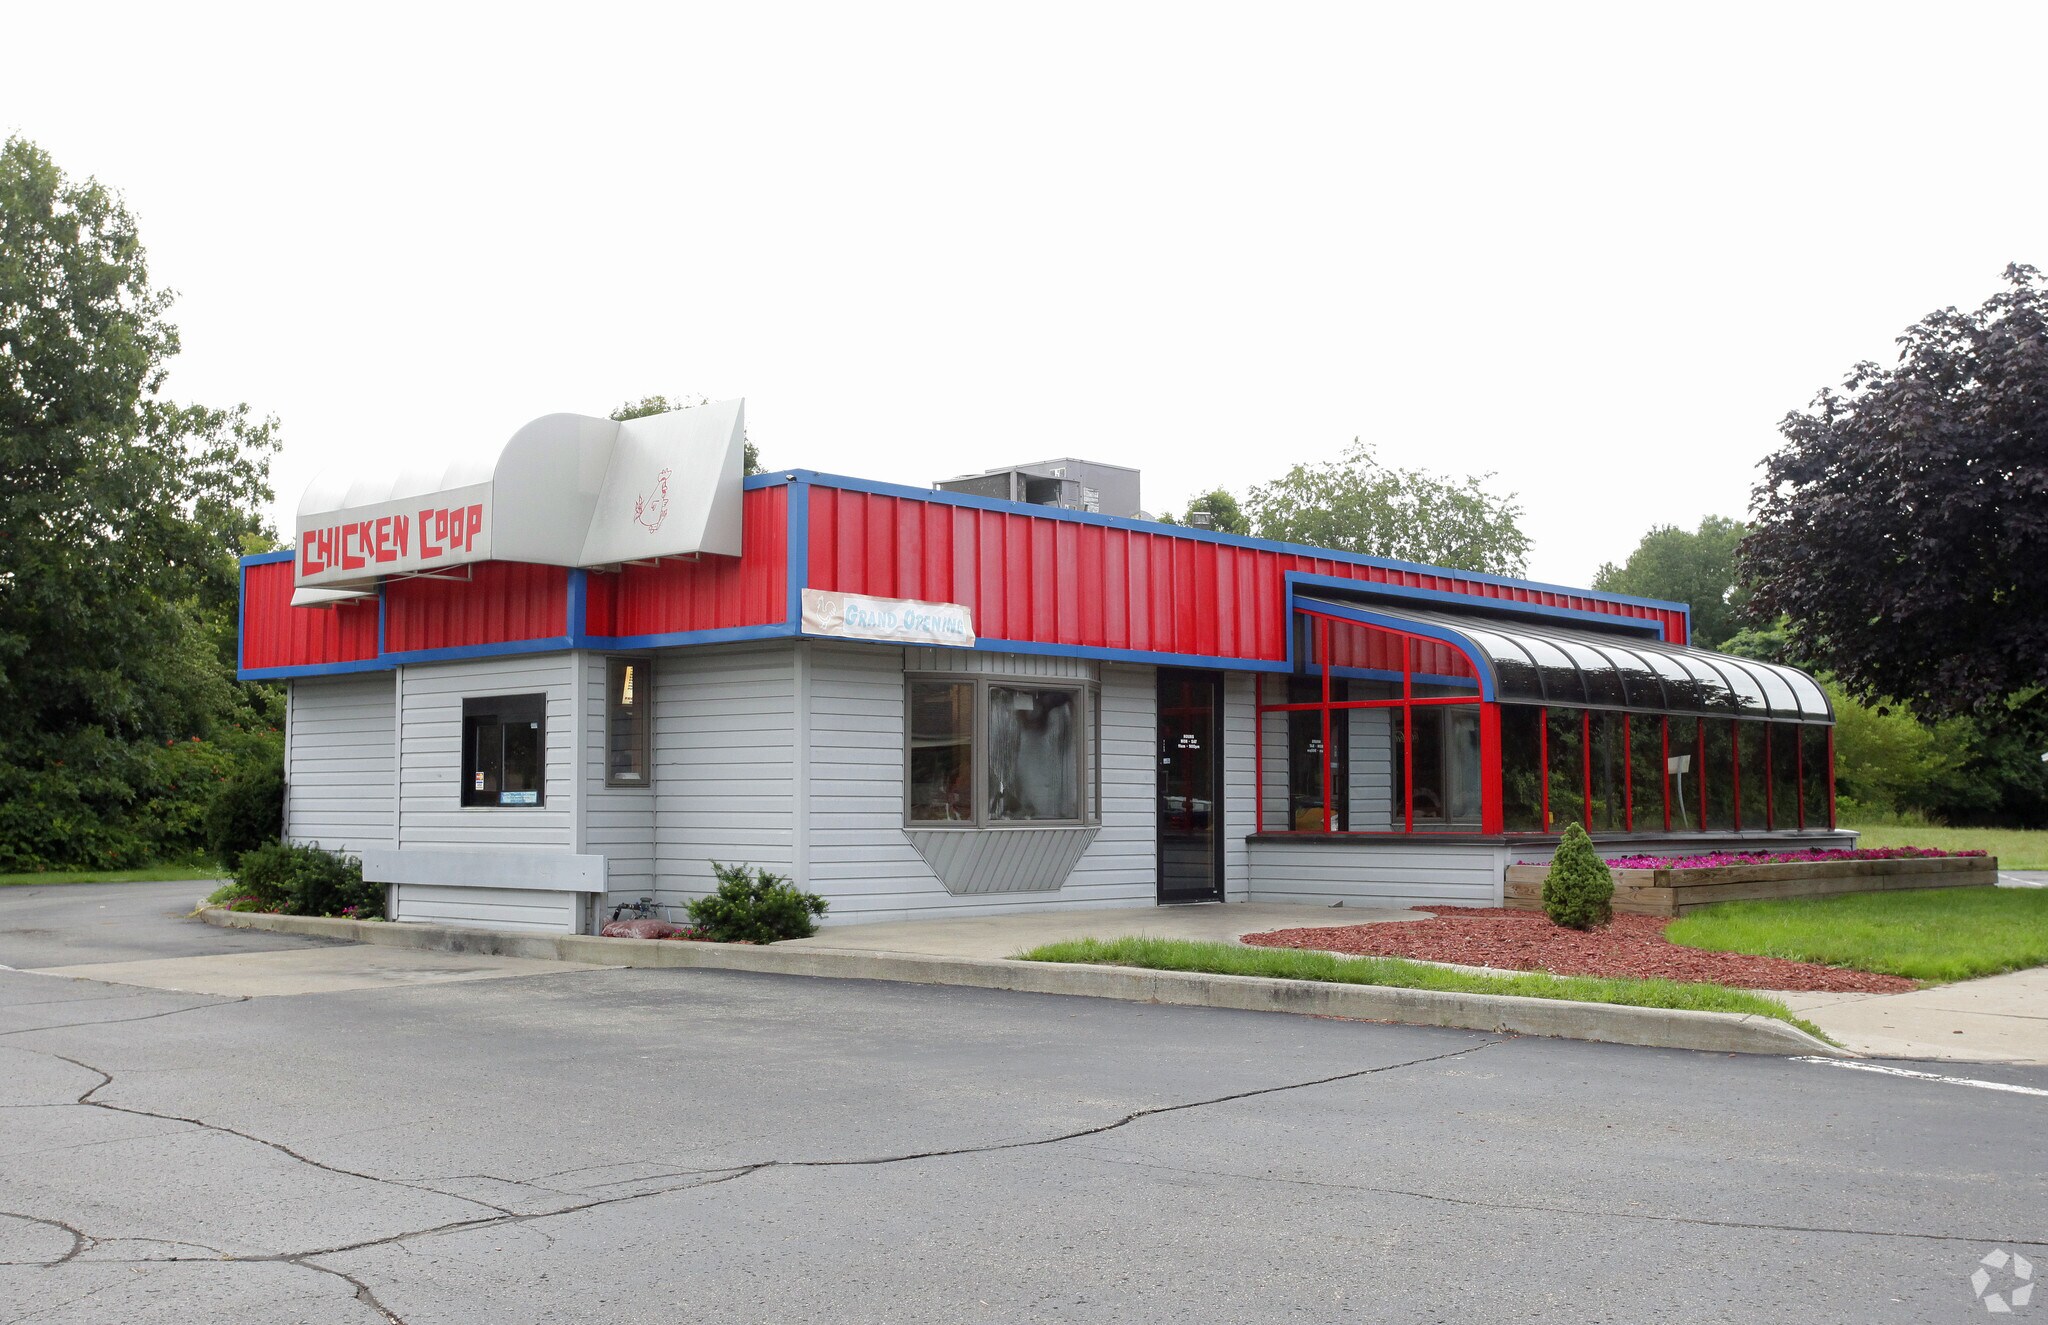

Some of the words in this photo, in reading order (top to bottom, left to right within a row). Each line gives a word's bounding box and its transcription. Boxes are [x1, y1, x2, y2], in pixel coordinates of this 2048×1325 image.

[302, 514, 409, 576] CHICKEN
[418, 503, 483, 560] COOP
[845, 604, 898, 630] GRAND
[903, 608, 965, 635] OPENING
